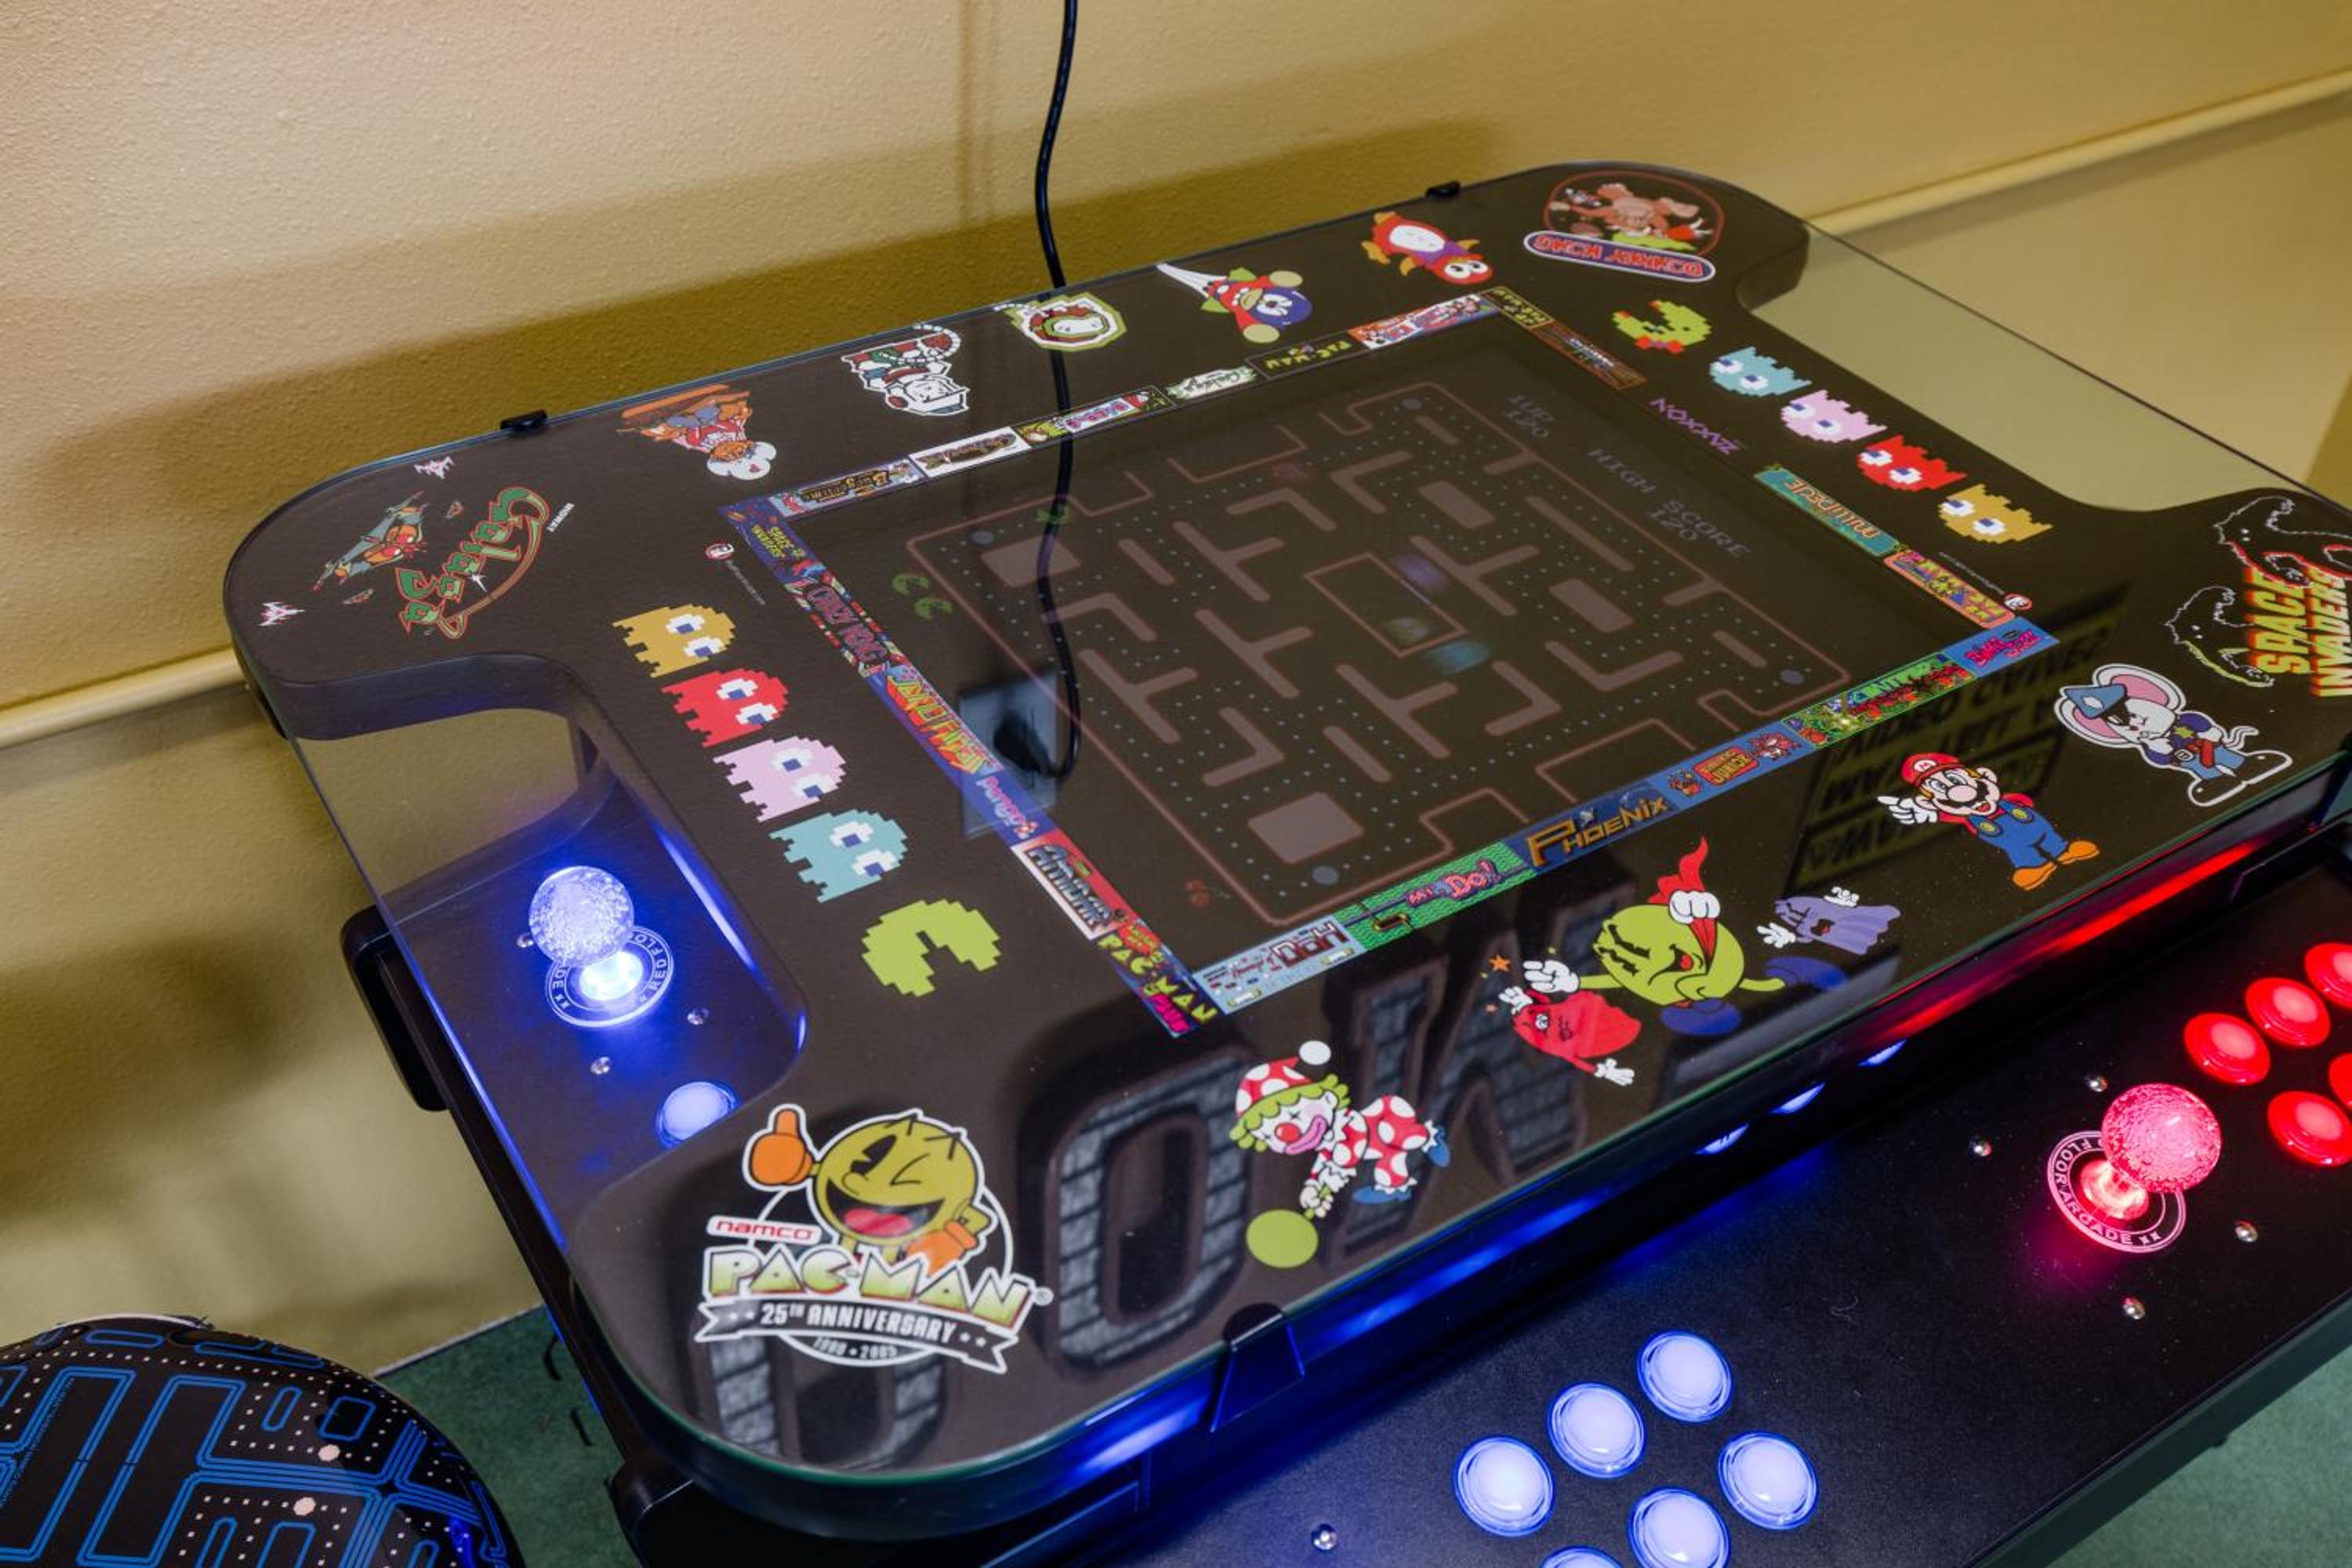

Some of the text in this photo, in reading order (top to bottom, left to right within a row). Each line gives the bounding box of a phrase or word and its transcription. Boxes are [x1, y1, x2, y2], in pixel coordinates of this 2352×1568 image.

[1533, 234, 1704, 278] DONKEY KONG
[1649, 397, 1743, 456] ZAXXON
[1587, 448, 1753, 558] HIGH SCORE
[2246, 567, 2311, 675] SPACE
[1098, 933, 1218, 1025] PAC-MAN
[717, 1221, 815, 1242] namco
[2053, 1137, 2134, 1245] FLOOR ARCADE
[708, 1247, 1033, 1330] PAC-MAN
[807, 1303, 956, 1343] ANNIVERSARY
